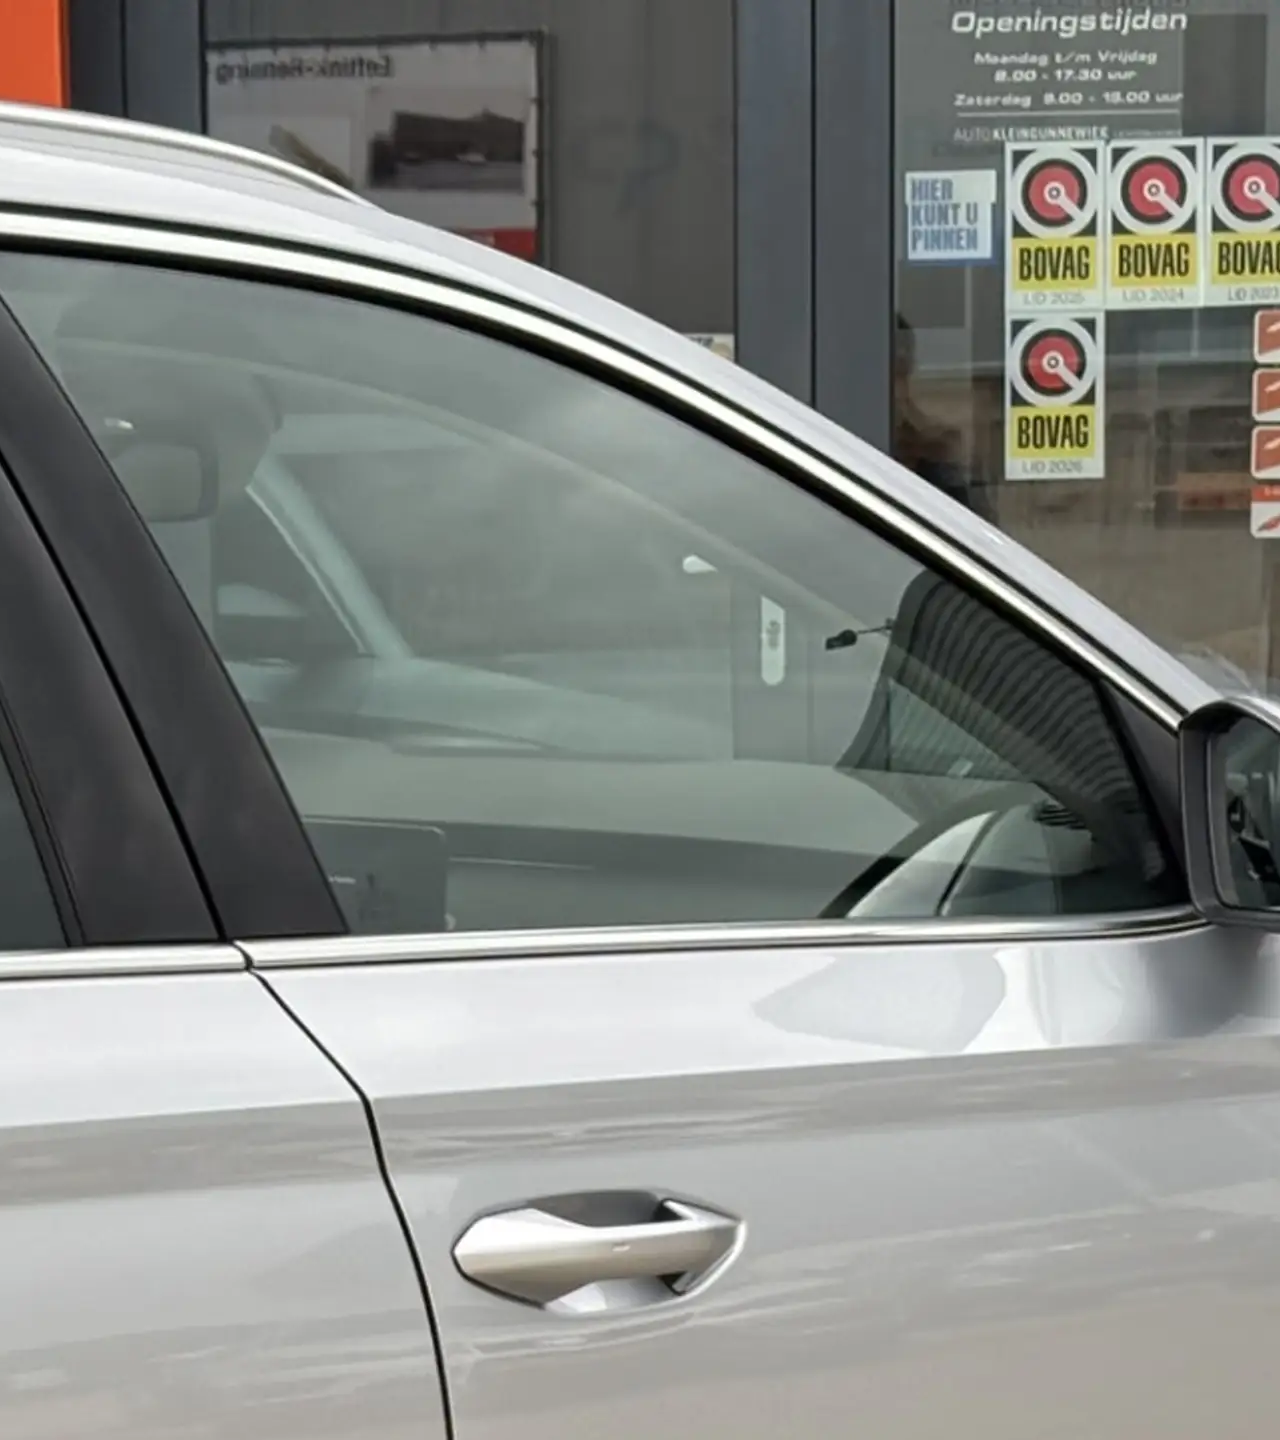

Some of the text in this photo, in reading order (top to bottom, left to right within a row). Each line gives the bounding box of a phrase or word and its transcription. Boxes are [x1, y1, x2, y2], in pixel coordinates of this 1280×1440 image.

[951, 7, 1188, 39] Openingstijden
[974, 50, 1158, 67] Maandag t/m Vrijdag
[994, 69, 1037, 83] 8.00
[1054, 67, 1102, 82] 17.30
[1108, 69, 1138, 80] uur
[953, 93, 1032, 108] Zaterdag
[1155, 91, 1185, 103] uur
[911, 178, 954, 200] HIER
[911, 202, 978, 226] KUNT U
[911, 227, 978, 251] PINNEN
[1018, 246, 1090, 281] BOVAG
[1118, 242, 1190, 278] BOVAG
[1024, 291, 1046, 305] LID
[1122, 288, 1184, 302] LID 2024
[1228, 287, 1247, 301] LID
[1017, 414, 1089, 449] BOVAG
[1022, 460, 1046, 474] LID
